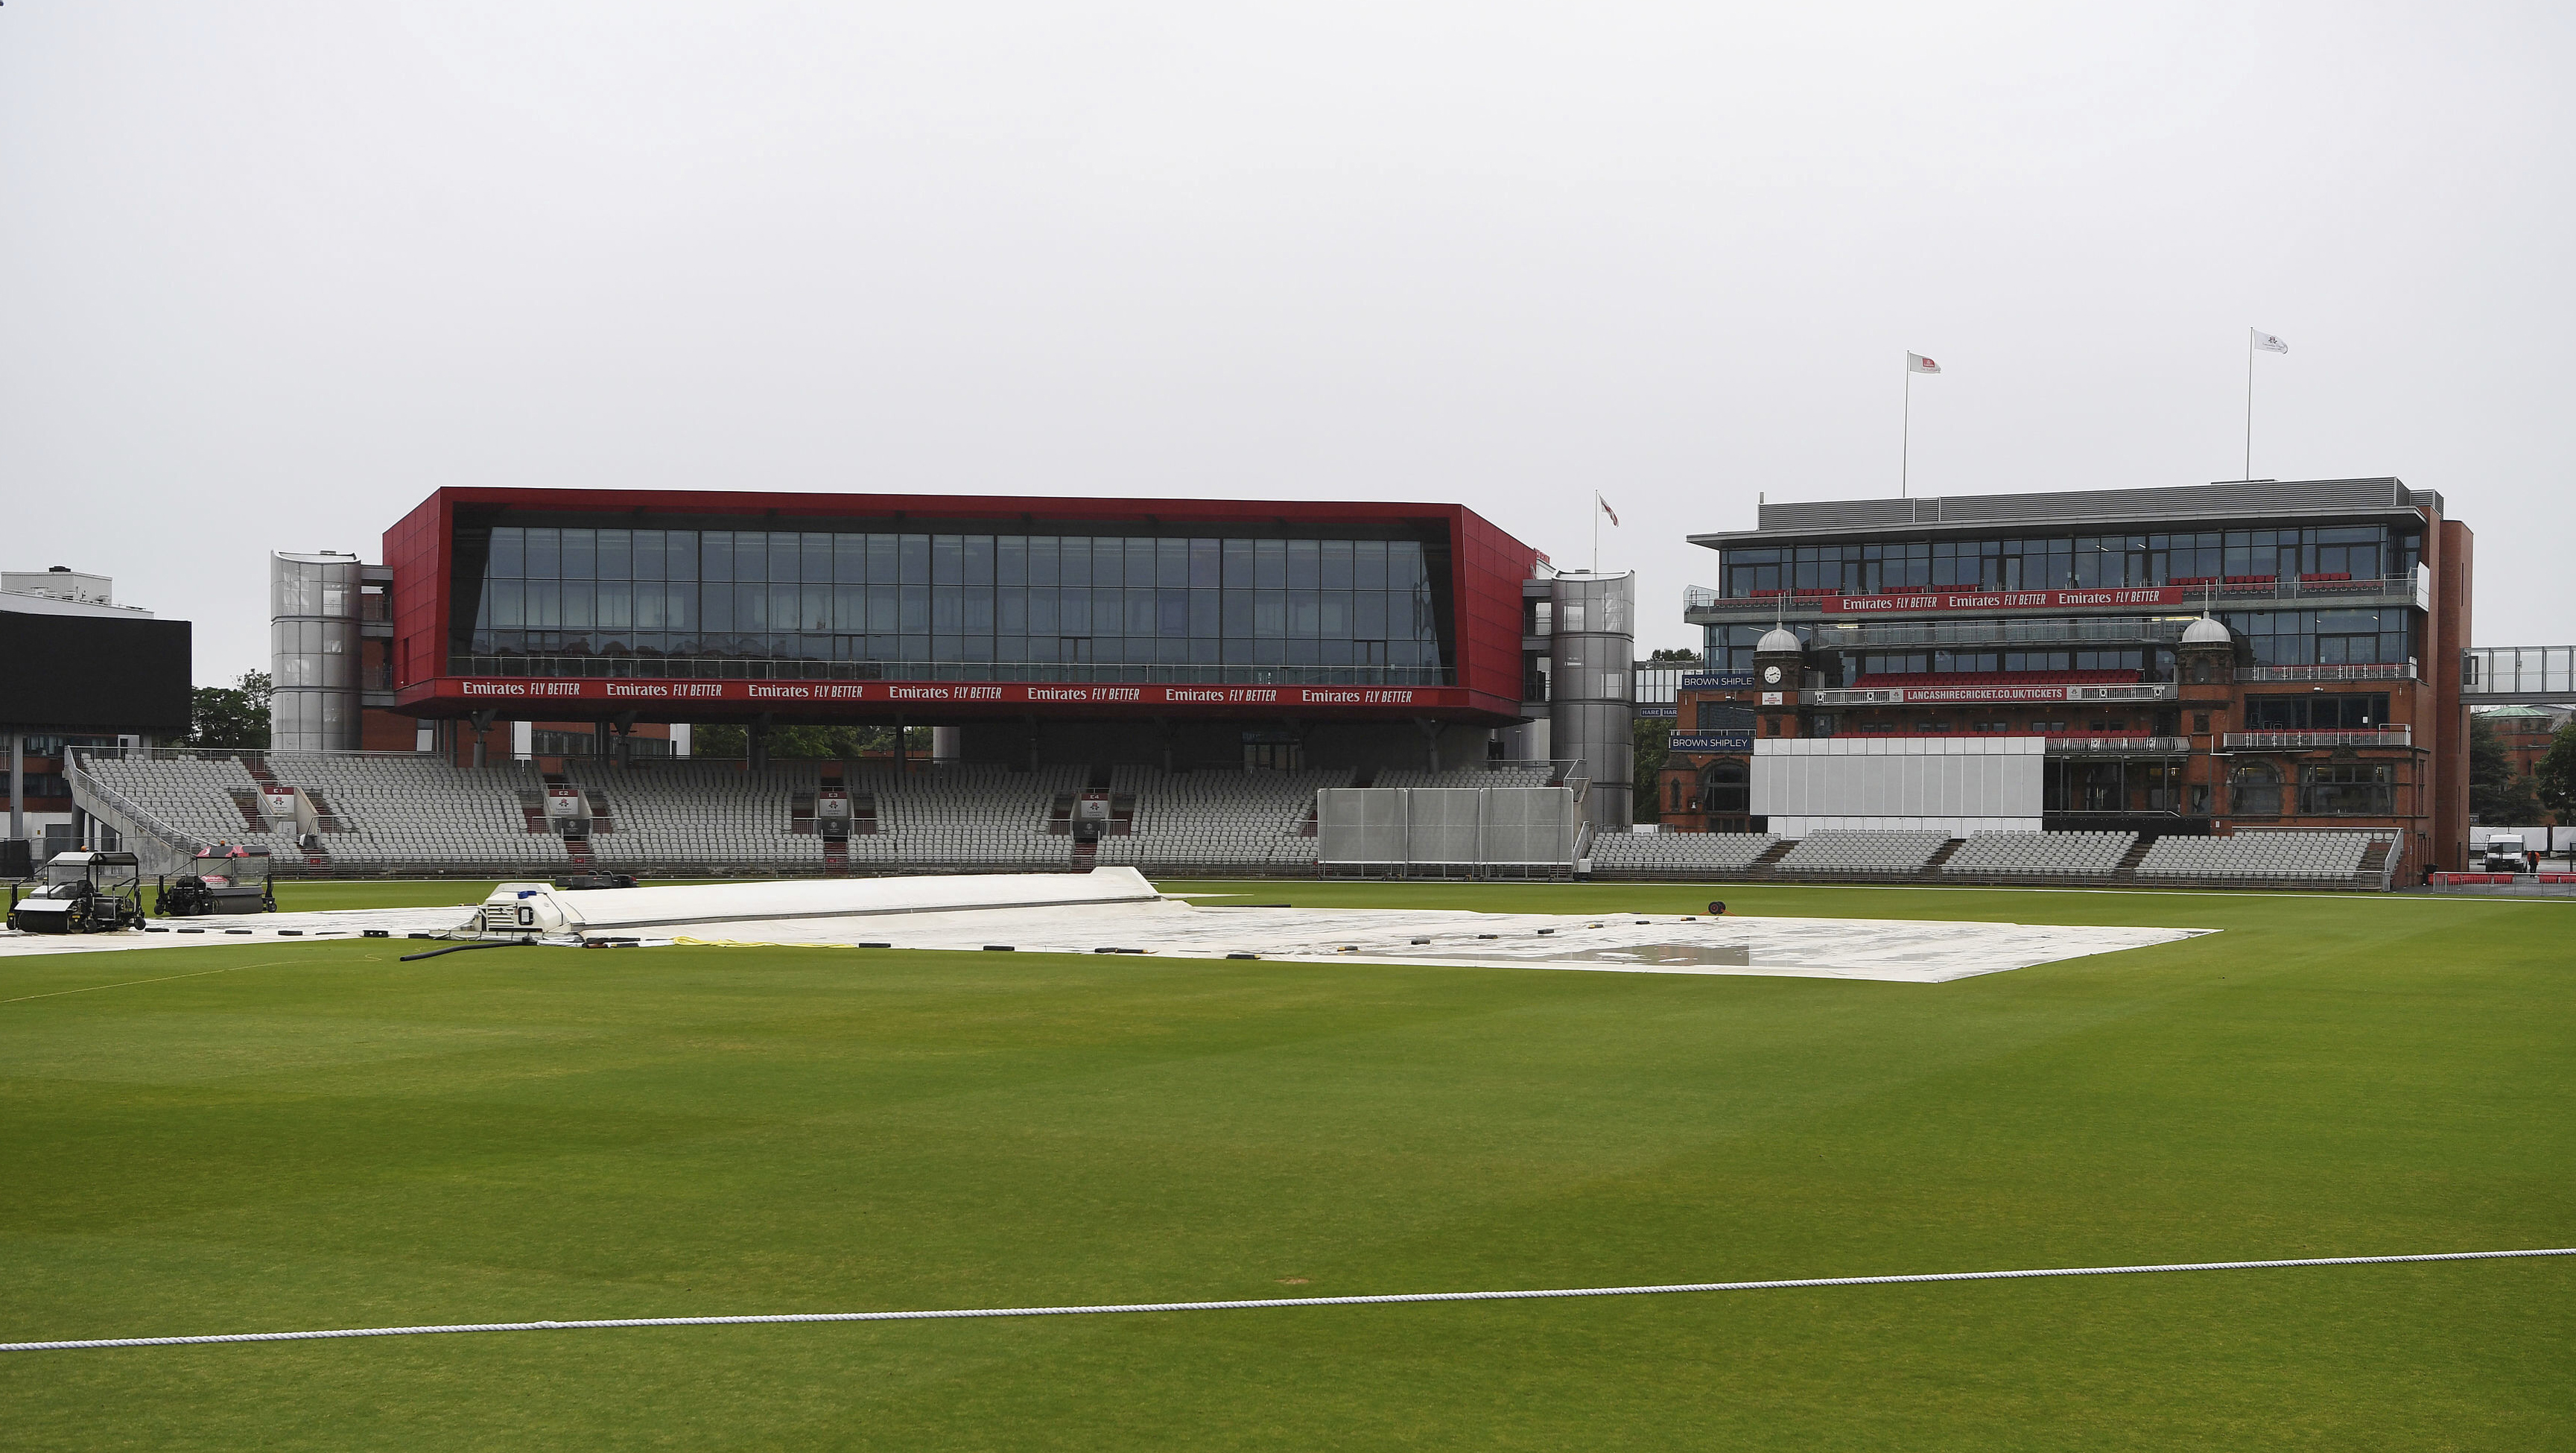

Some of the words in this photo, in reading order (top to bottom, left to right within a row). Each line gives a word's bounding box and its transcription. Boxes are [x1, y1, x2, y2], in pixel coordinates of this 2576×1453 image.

[1843, 598, 1892, 610] Emirates
[1896, 597, 1909, 608] FLY
[1911, 597, 1937, 608] BETTER
[1949, 595, 1999, 607] Emirates
[2004, 595, 2017, 606] FLY
[2019, 594, 2046, 605] BETTER
[2058, 592, 2111, 604] Emirates
[2116, 592, 2129, 603] FLY
[2131, 591, 2159, 602] BETTER
[1722, 677, 1754, 686] SHIPLE
[463, 682, 524, 695] Emirates
[530, 683, 545, 694] FLY
[548, 683, 580, 695] BETTER
[606, 683, 667, 696] Emirates
[673, 684, 688, 696] FLY
[690, 684, 722, 697] BETTER
[748, 685, 809, 697] Emirates
[814, 686, 829, 697] FLY
[831, 686, 863, 698] BETTER
[889, 686, 948, 699] Emirates
[954, 686, 968, 699] FLY
[970, 686, 1002, 699] BETTER
[1027, 687, 1087, 700] Emirates
[1092, 688, 1106, 700] FLY
[1108, 688, 1140, 700] BETTER
[1166, 688, 1224, 701] Emirates
[1229, 689, 1244, 701] FLY
[1246, 689, 1277, 702] BETTER
[1908, 688, 2062, 700] LANCASHIRECRICKET.CO.UK/TICKETS
[1302, 689, 1360, 703] Emirates
[1365, 691, 1379, 703] FLY
[1381, 691, 1412, 703] BETTER
